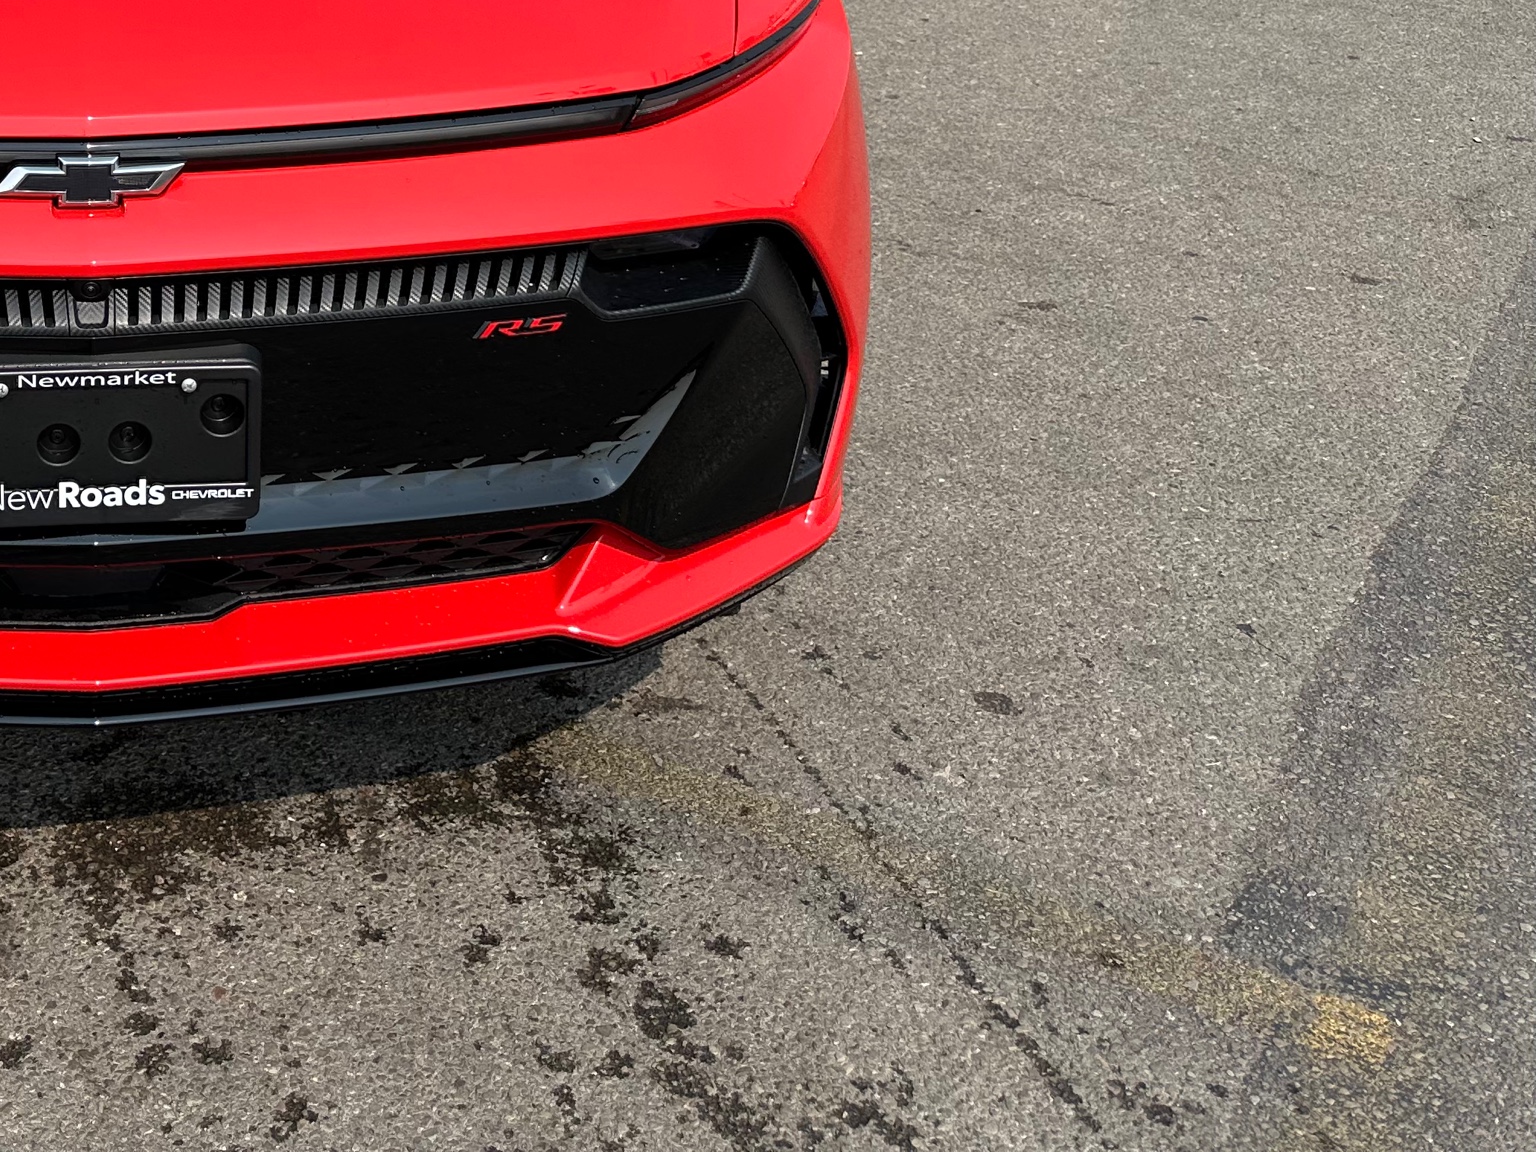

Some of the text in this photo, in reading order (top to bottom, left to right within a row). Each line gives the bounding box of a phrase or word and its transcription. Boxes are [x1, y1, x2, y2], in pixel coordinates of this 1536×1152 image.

[472, 312, 568, 339] RS
[17, 370, 177, 389] Newmarket
[171, 488, 255, 501] CHEVROLET
